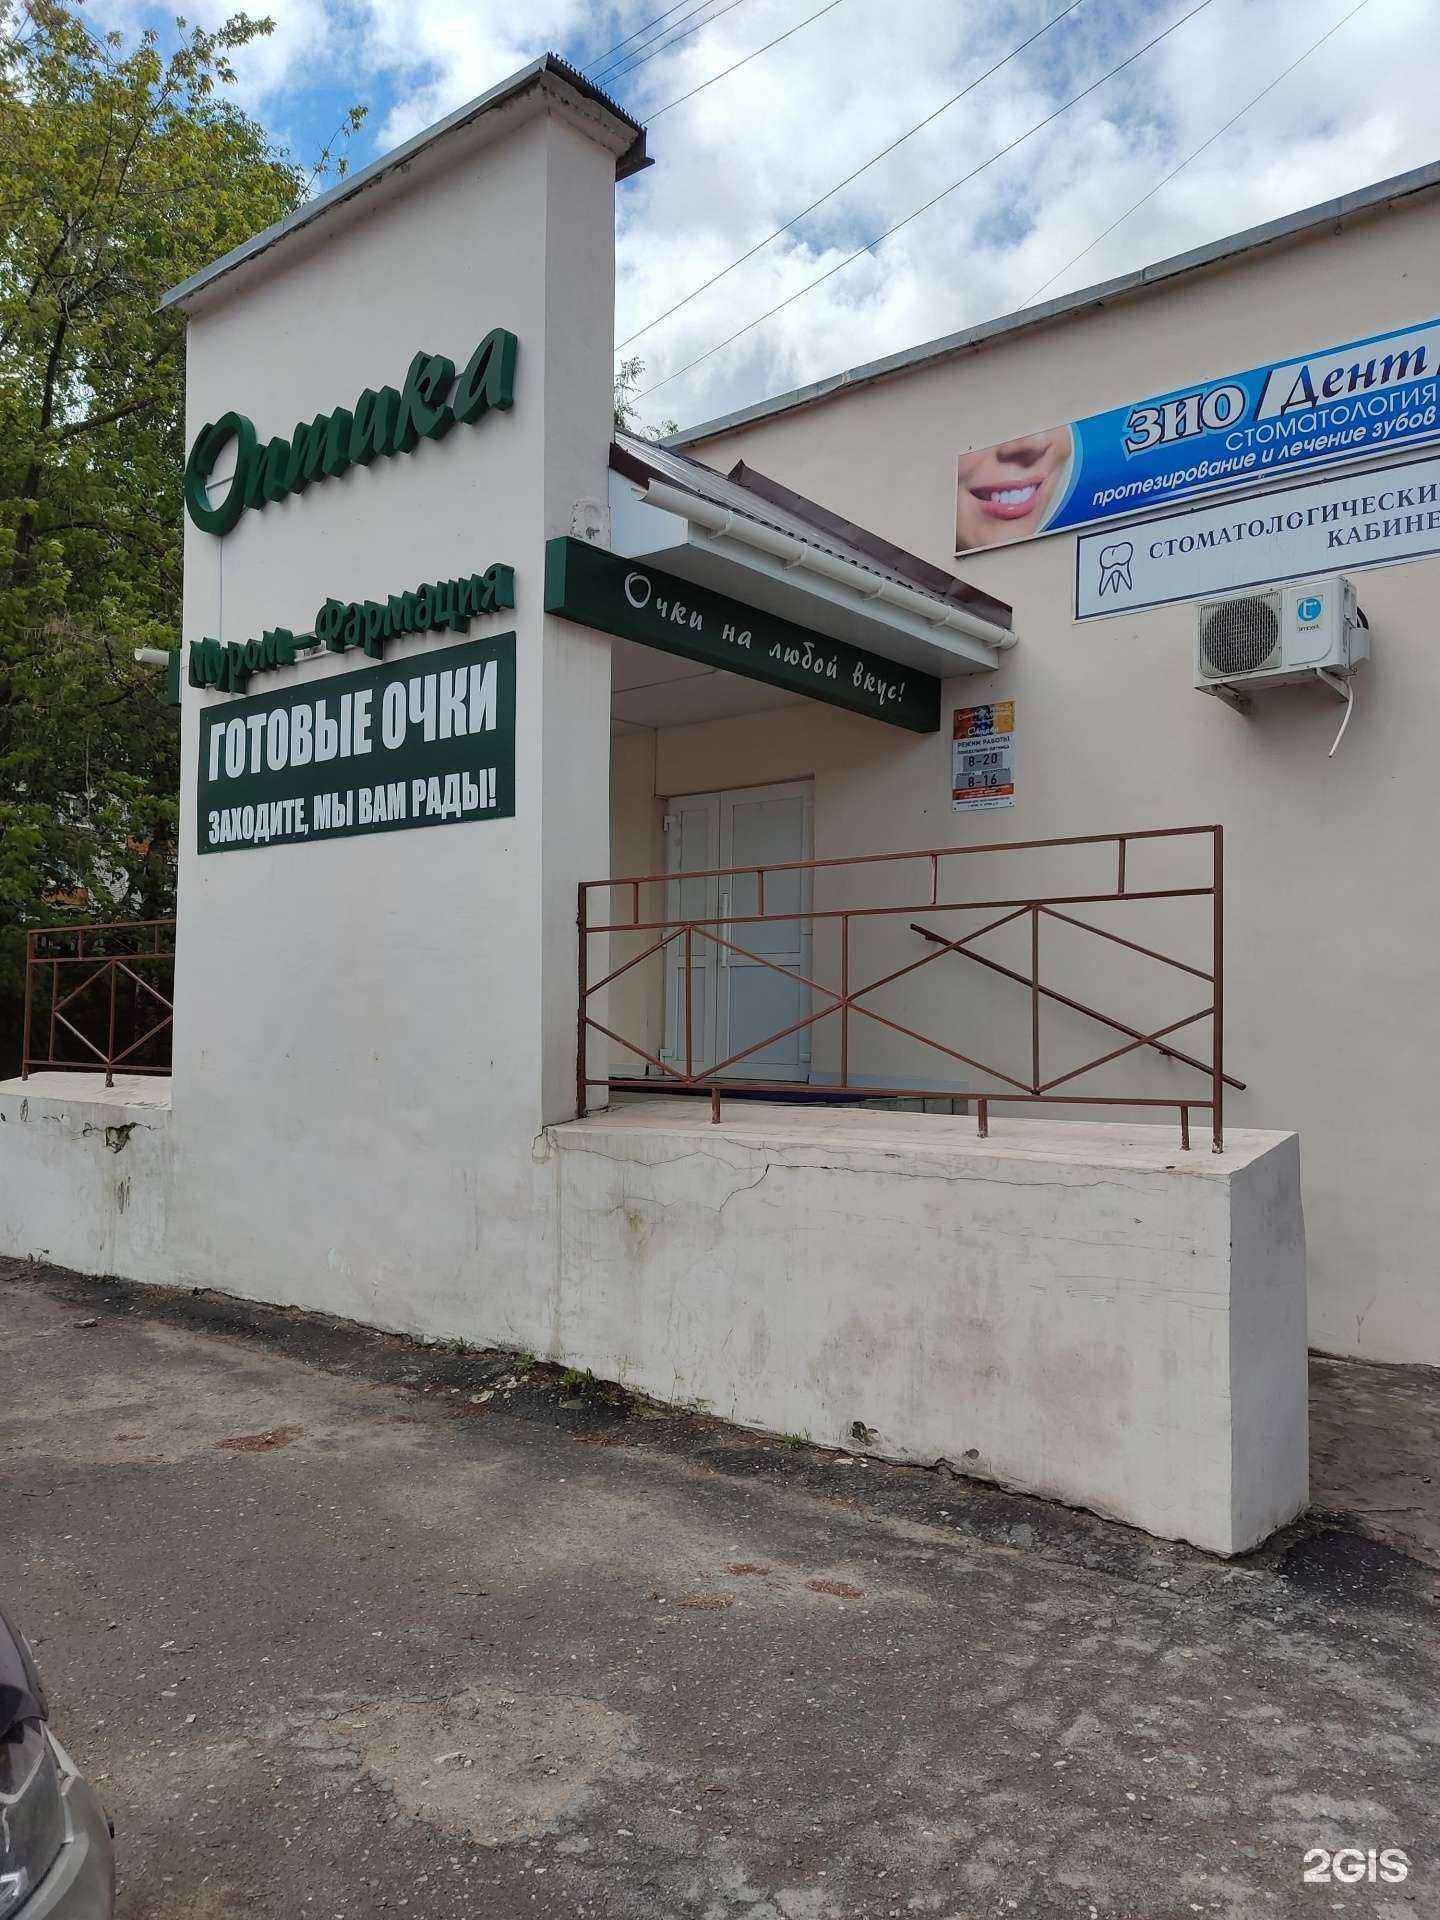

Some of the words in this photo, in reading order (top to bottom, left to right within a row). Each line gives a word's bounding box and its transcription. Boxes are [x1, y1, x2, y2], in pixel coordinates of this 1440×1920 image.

[184, 328, 518, 536] Оптика
[1124, 385, 1246, 455] ЗИО
[1280, 345, 1428, 416] Дент
[1092, 452, 1256, 507] протезирование
[1261, 448, 1274, 463] и
[1278, 426, 1367, 459] лечение
[1372, 405, 1437, 439] зубов
[1149, 483, 1440, 560] СТОМАТОЛОГИЧЕСКИ
[624, 571, 704, 631] Очки
[721, 623, 752, 650] на
[769, 641, 839, 680] любой
[852, 661, 906, 706] вкус!
[207, 689, 373, 782] ГОТОВЫЕ
[382, 659, 498, 751] ОЧКИ
[208, 797, 309, 845] ЗАХОДИТЕ,
[313, 790, 352, 831] МЫ
[359, 781, 406, 824] ВАМ
[412, 767, 497, 821] РАДЫ!
